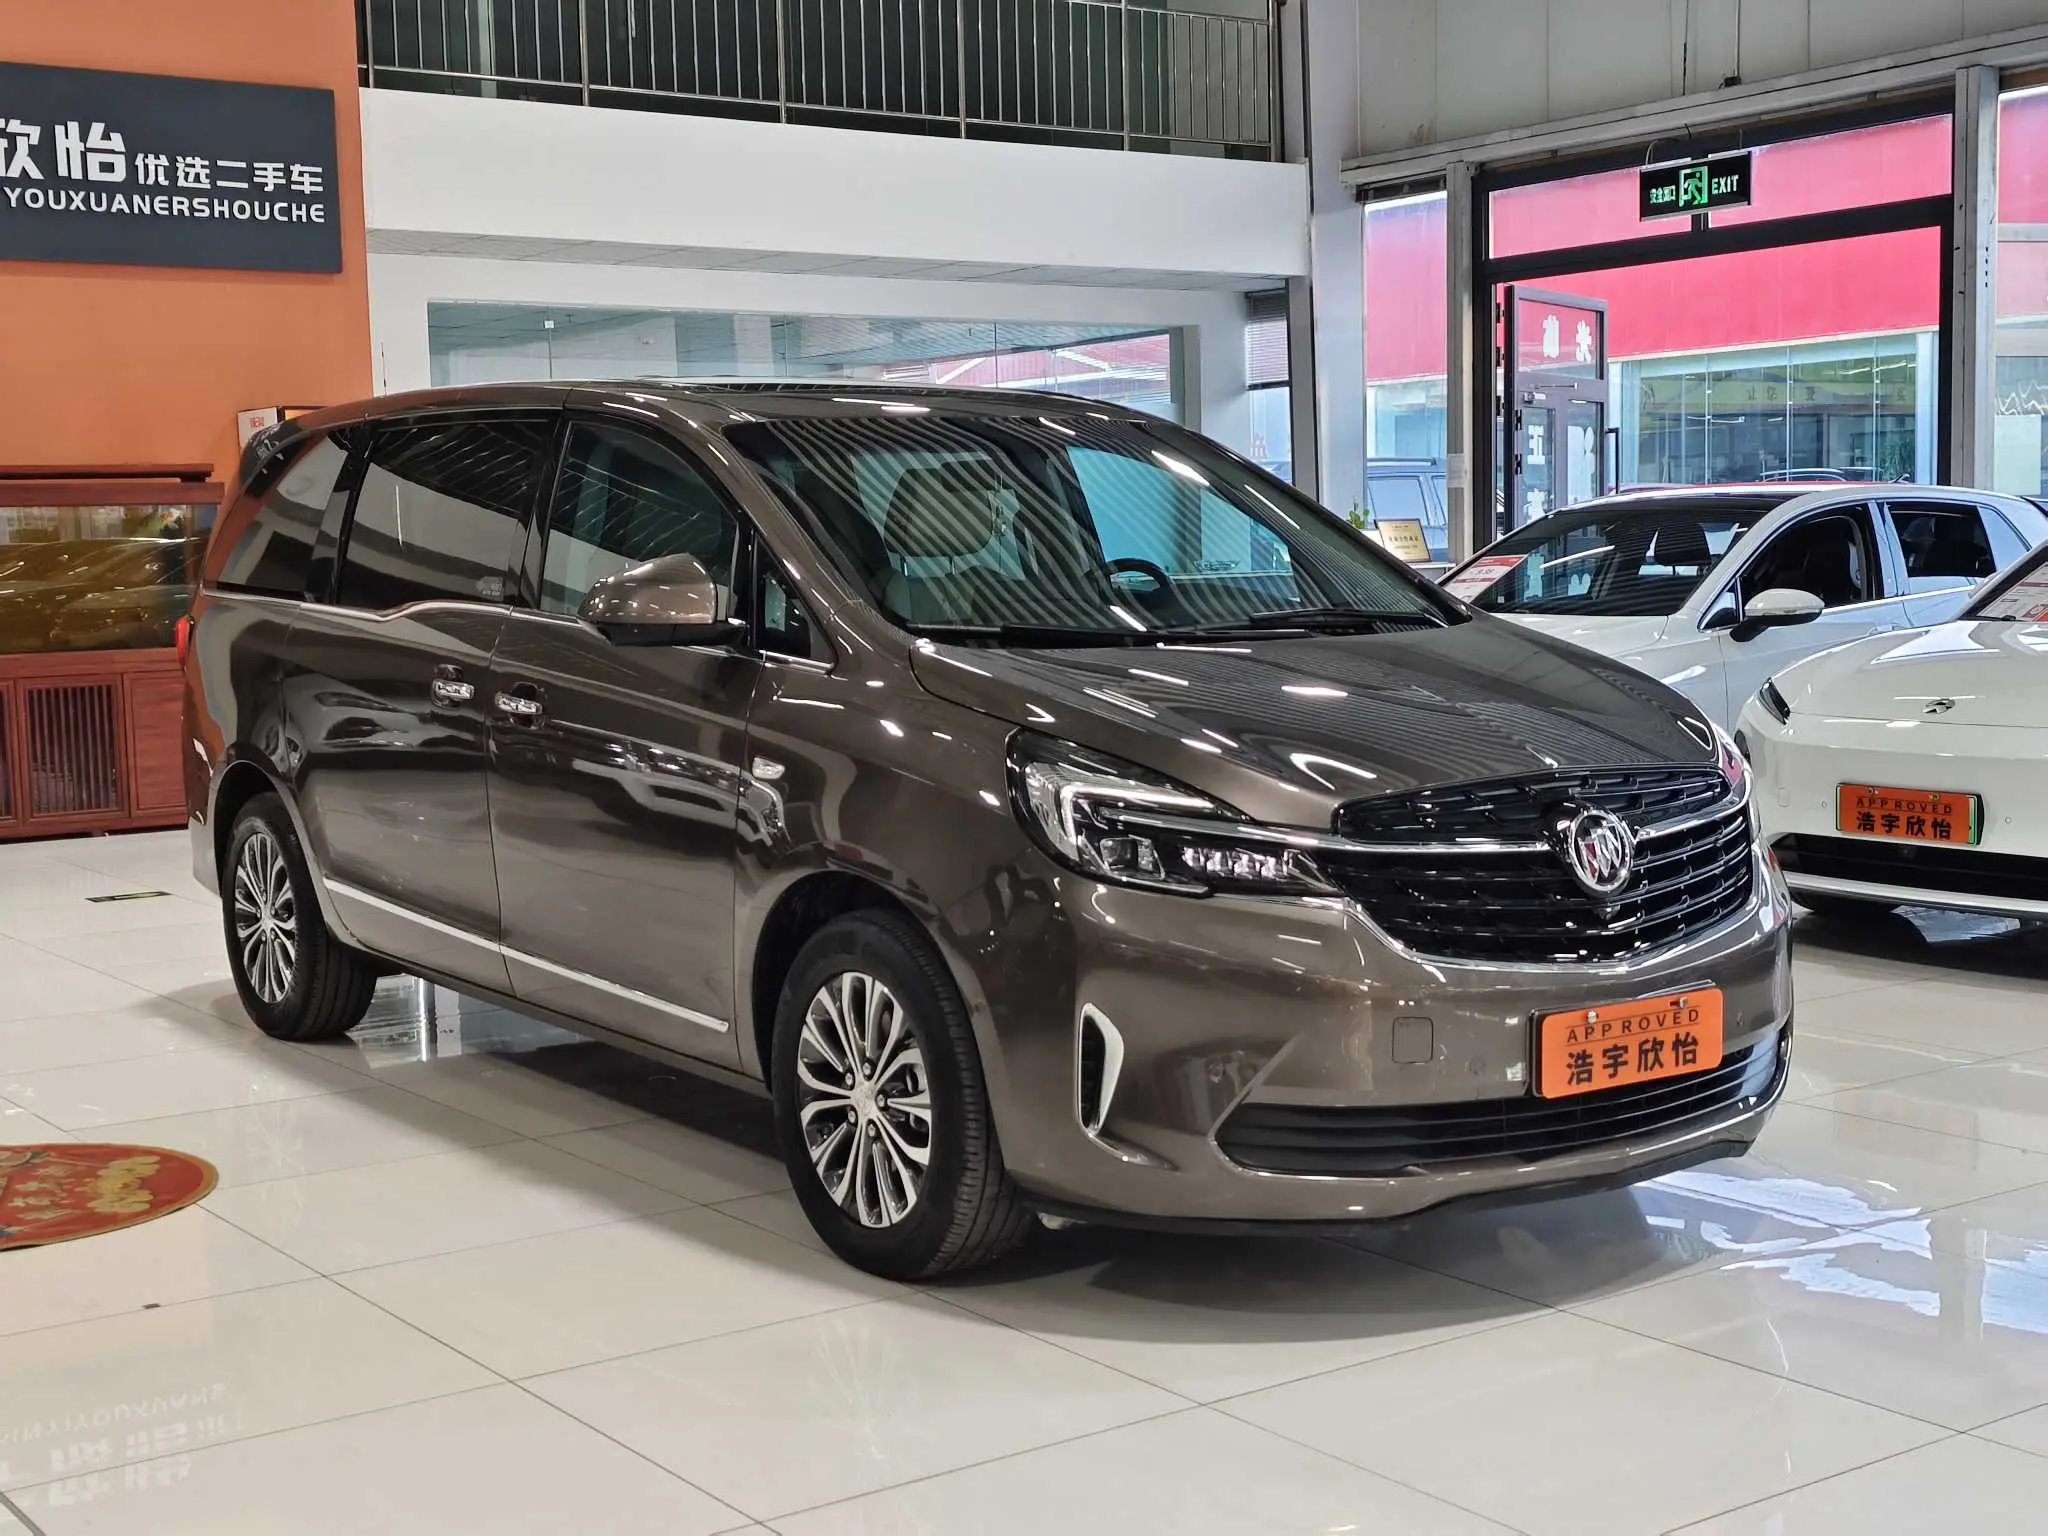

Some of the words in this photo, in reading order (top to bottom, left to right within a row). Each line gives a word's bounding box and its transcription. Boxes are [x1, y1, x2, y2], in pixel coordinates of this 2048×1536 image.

[134, 153, 324, 194] 优选二手车
[1712, 175, 1739, 195] EXIT
[5, 187, 325, 222] YOUXUANERSHOUCHE
[1856, 798, 1952, 814] APPROVED
[1856, 811, 1952, 840] 浩宇欣怡
[1567, 1009, 1699, 1043] APPROVED
[1566, 1032, 1699, 1086] 浩宇欣怡
